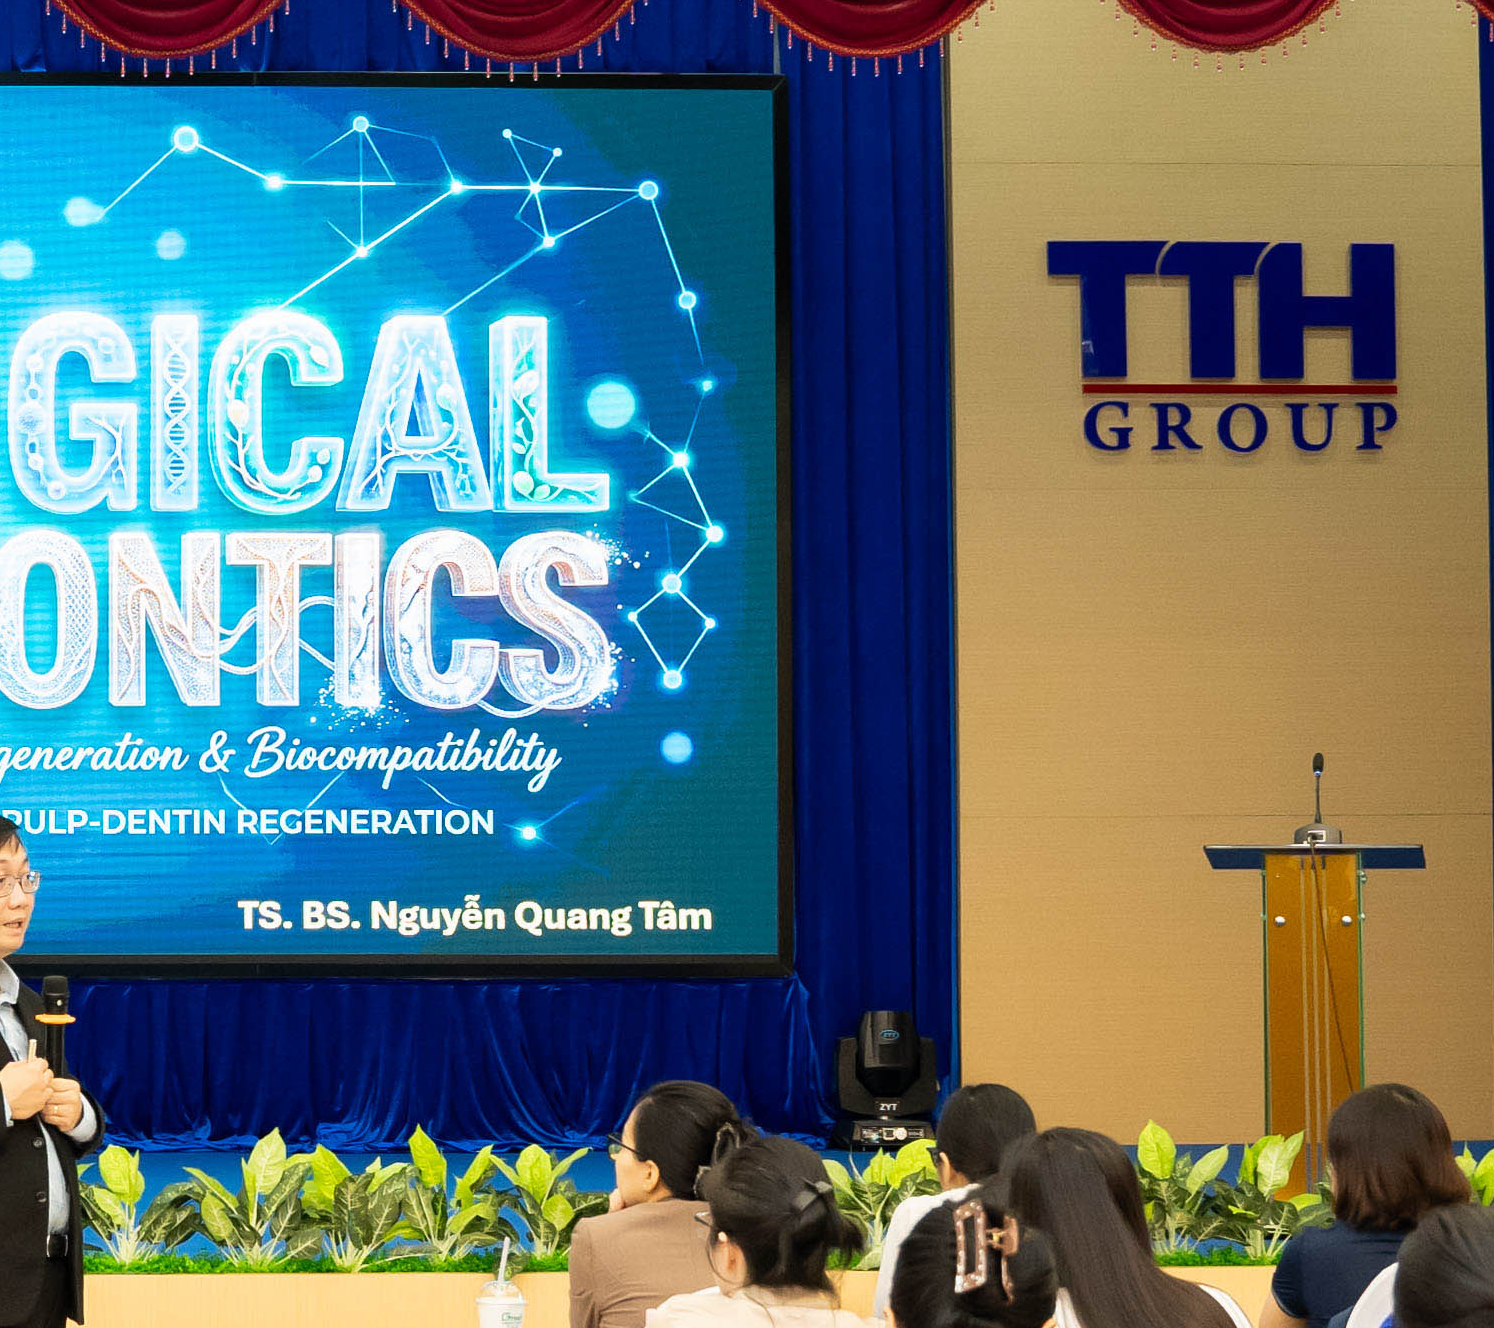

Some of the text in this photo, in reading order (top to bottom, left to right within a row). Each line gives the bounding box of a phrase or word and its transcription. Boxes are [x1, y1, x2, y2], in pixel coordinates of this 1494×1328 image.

[1047, 240, 1397, 380] TTH
[1083, 401, 1398, 453] GROUP
[201, 736, 236, 773] &
[245, 725, 562, 793] Biocompatibility
[238, 809, 495, 836] REGENERATION
[237, 895, 712, 936] TS. BS. Nguyễn Quang Tâm
[879, 1103, 897, 1111] ZYT
